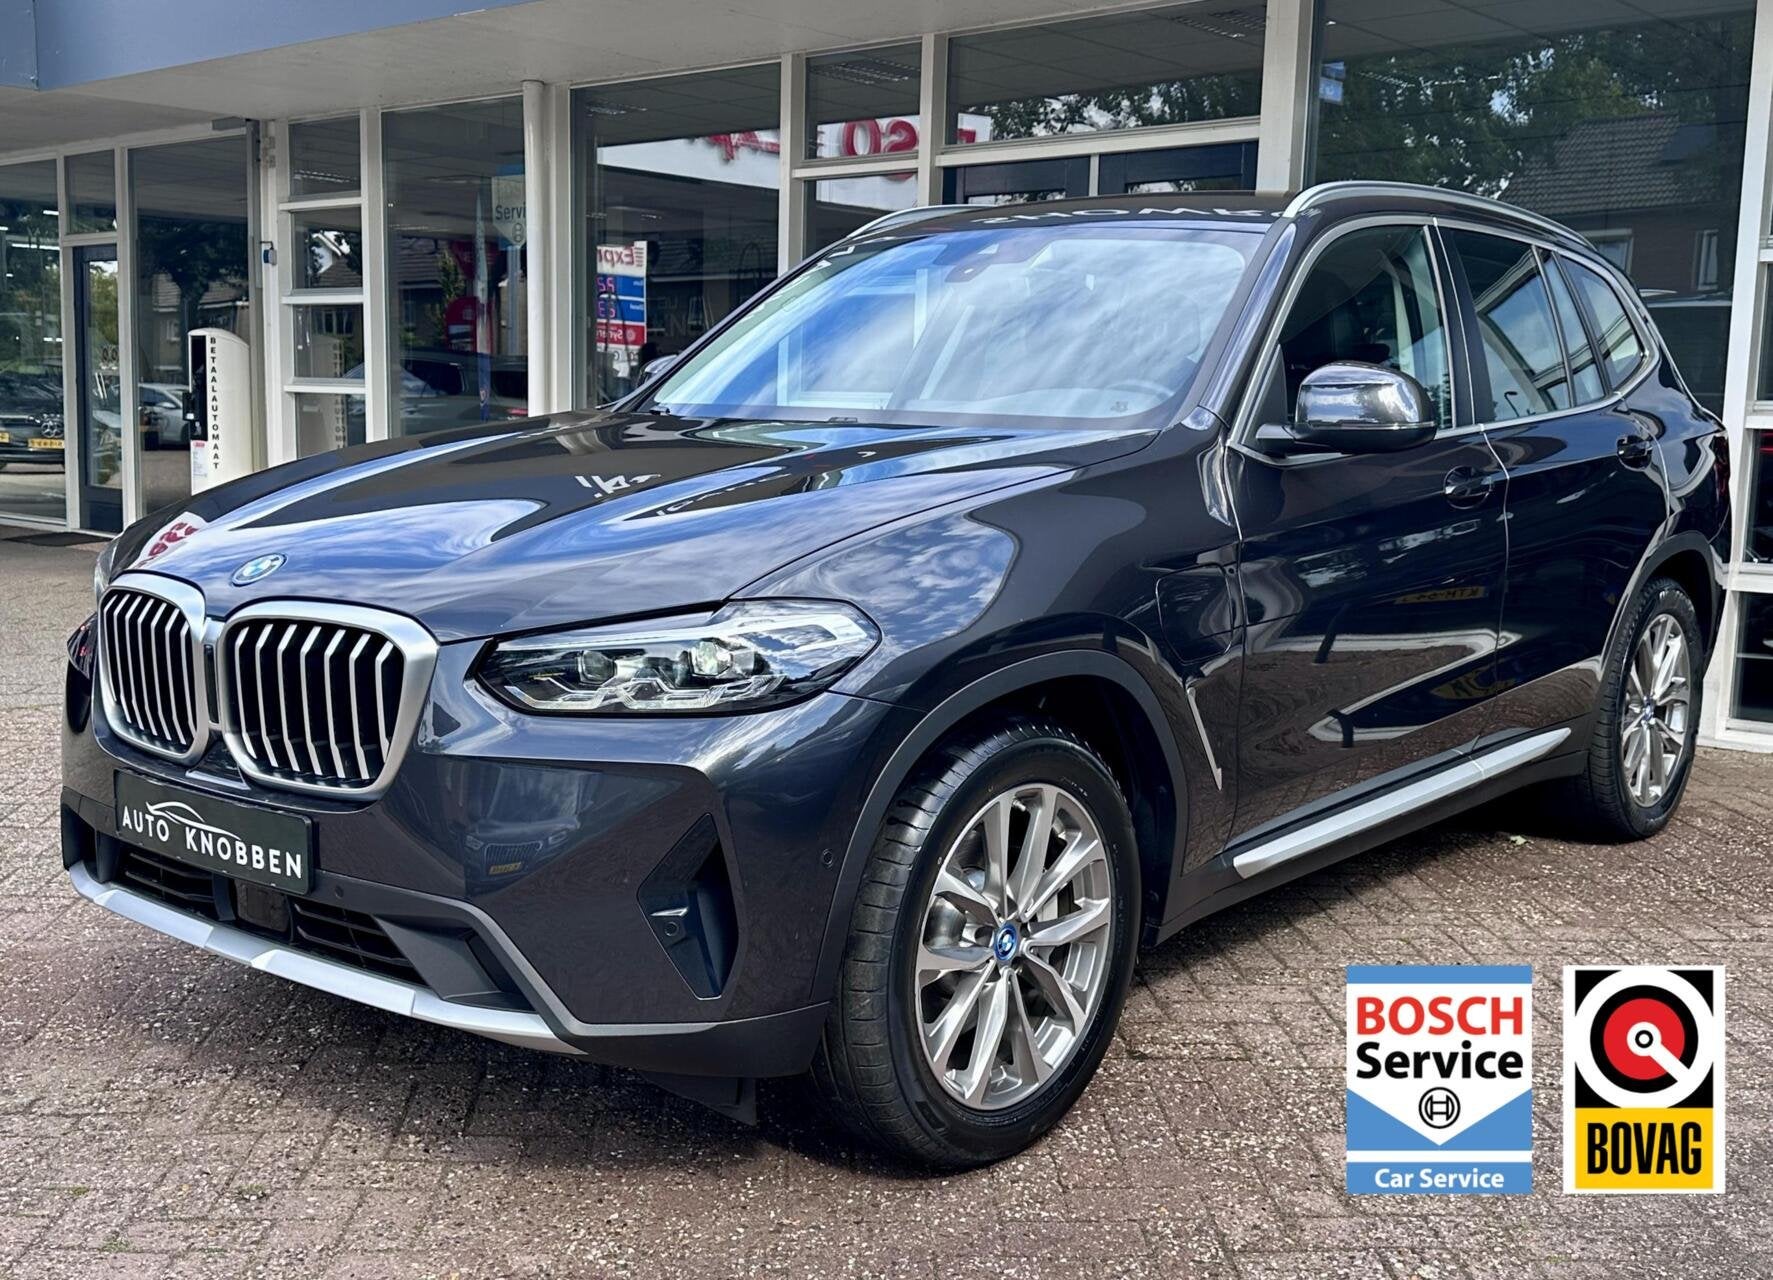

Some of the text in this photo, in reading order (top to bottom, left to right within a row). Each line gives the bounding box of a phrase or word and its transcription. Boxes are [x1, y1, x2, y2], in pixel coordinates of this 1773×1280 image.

[495, 201, 527, 220] Servi
[210, 337, 220, 469] BETAALAUTOMAAT
[122, 805, 302, 879] AUTO KNOBBEN
